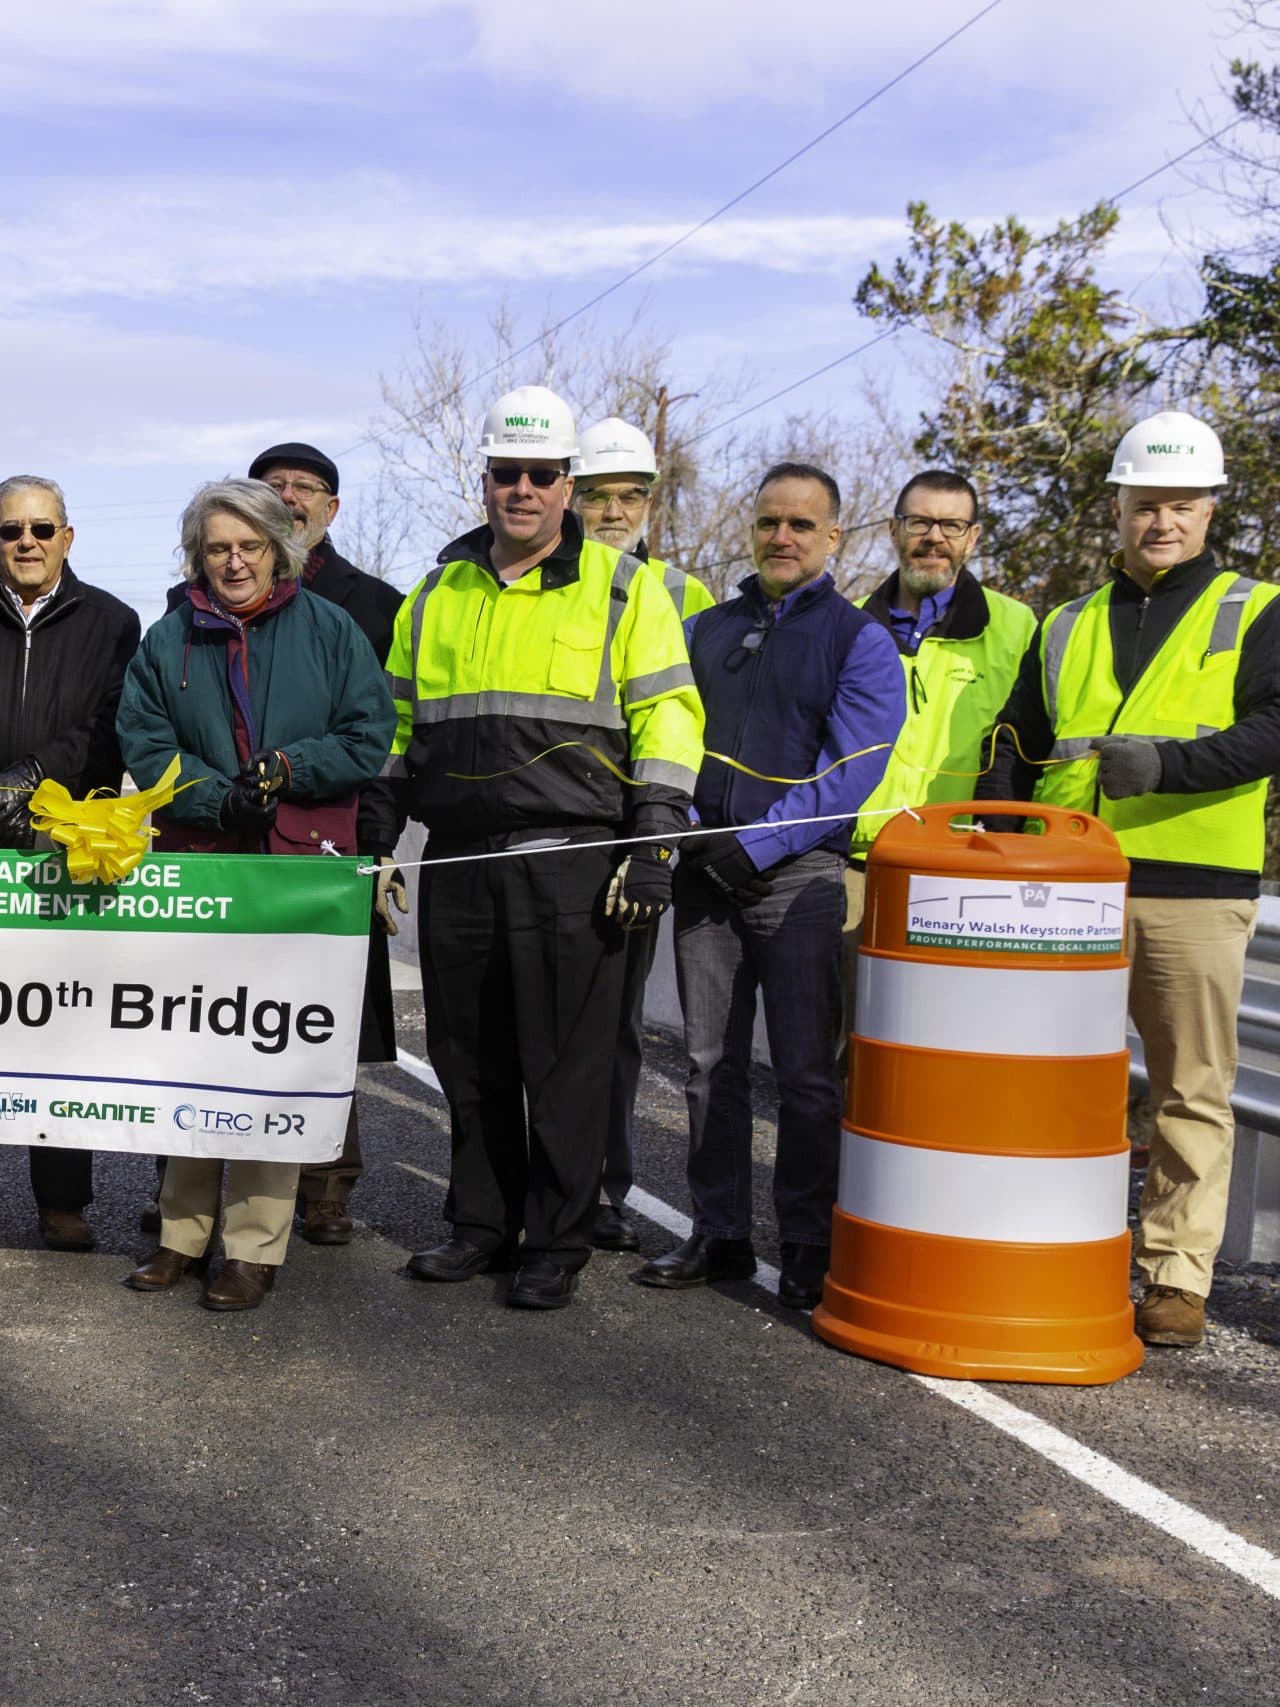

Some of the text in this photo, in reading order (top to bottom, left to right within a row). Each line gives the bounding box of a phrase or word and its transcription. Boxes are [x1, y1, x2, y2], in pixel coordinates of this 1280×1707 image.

[71, 863, 181, 888] DGE
[99, 894, 233, 919] PROJECT
[1024, 889, 1045, 901] PA
[912, 917, 964, 935] Plenary
[969, 921, 1015, 935] Walsh
[1020, 924, 1084, 938] Keystone
[910, 934, 952, 945] PROVEN
[957, 938, 1047, 951] PERFORMANCE.
[1052, 943, 1084, 951] LOCAL
[110, 983, 335, 1054] Bridge
[49, 1100, 155, 1124] GRANITE
[199, 1109, 253, 1131] TRC
[264, 1113, 305, 1136] HDR
